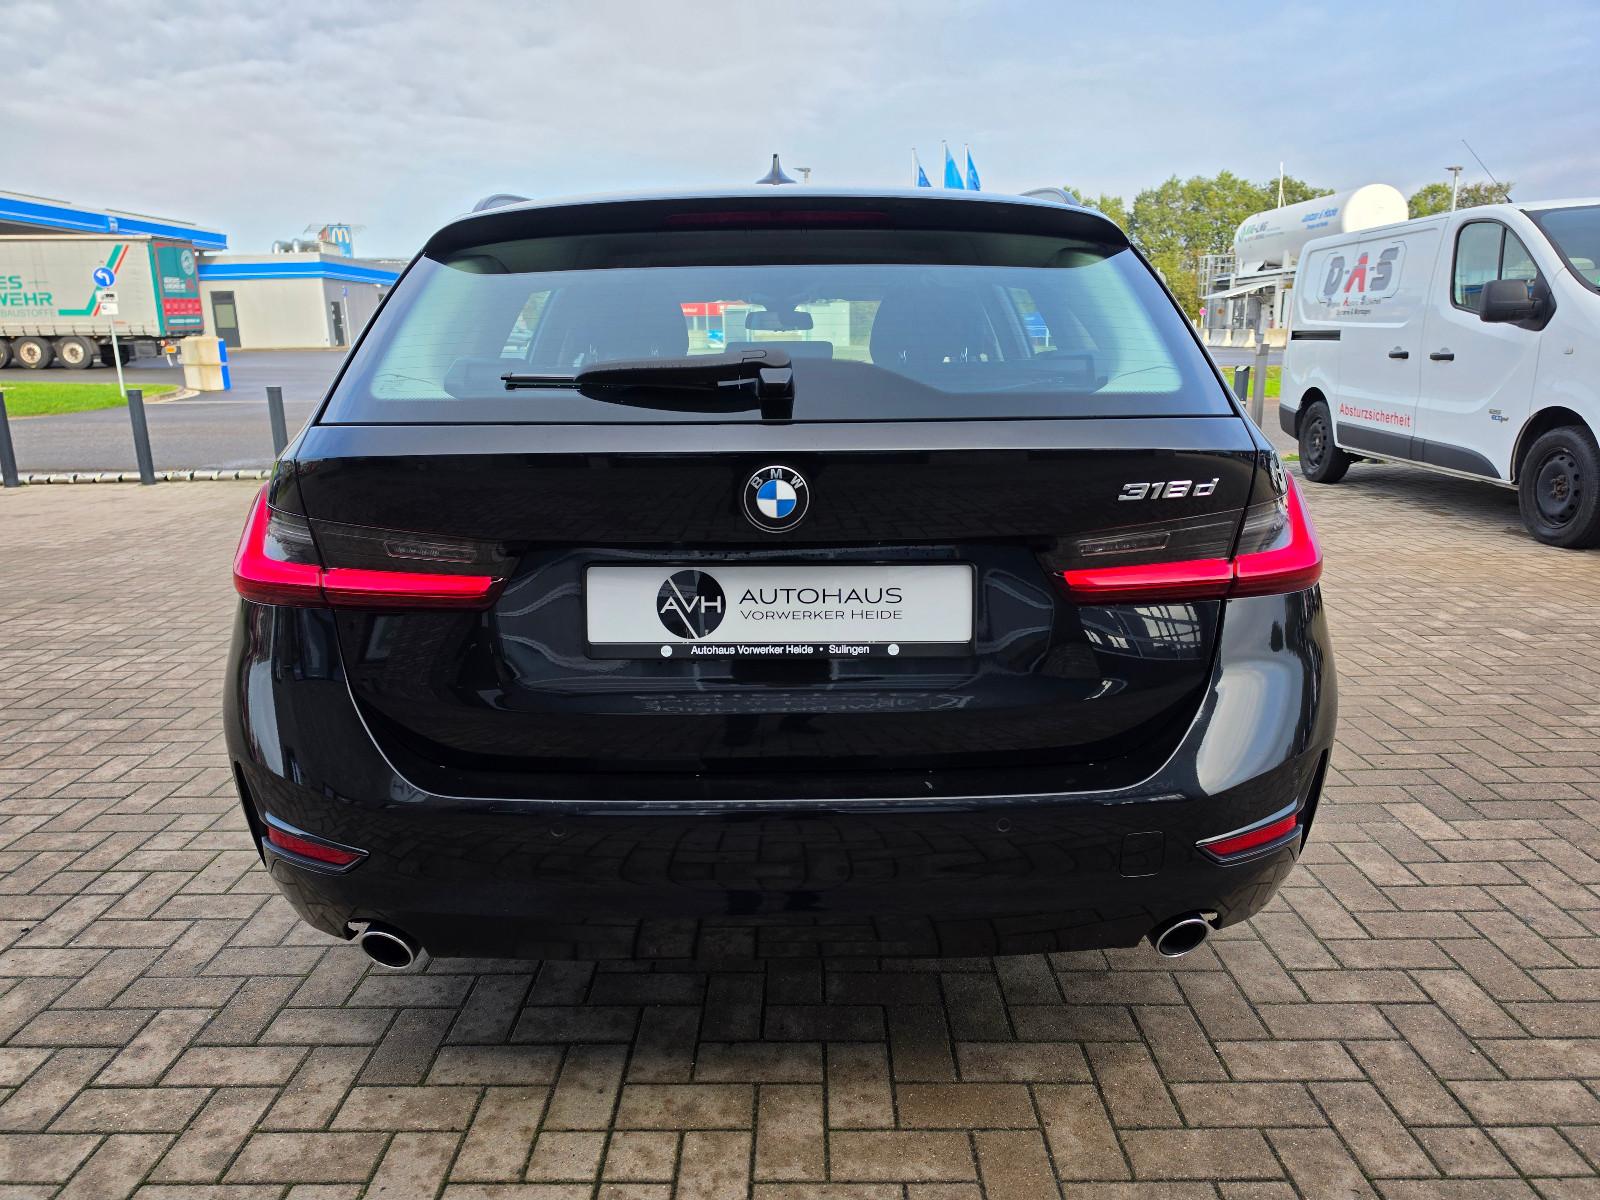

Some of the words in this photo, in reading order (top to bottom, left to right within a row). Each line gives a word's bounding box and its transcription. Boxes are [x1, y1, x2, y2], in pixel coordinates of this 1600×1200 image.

[1339, 403, 1410, 428] Absturzsicherheit
[750, 468, 804, 490] BMW
[1118, 478, 1219, 500] 318d
[739, 587, 903, 604] AUTOHAUS
[740, 609, 845, 620] VORWERKER
[851, 609, 903, 620] HEIDE
[691, 645, 735, 655] Autohaus
[737, 645, 784, 655] Vorwerker
[785, 645, 813, 655] Heide
[828, 645, 870, 656] Sulingen
